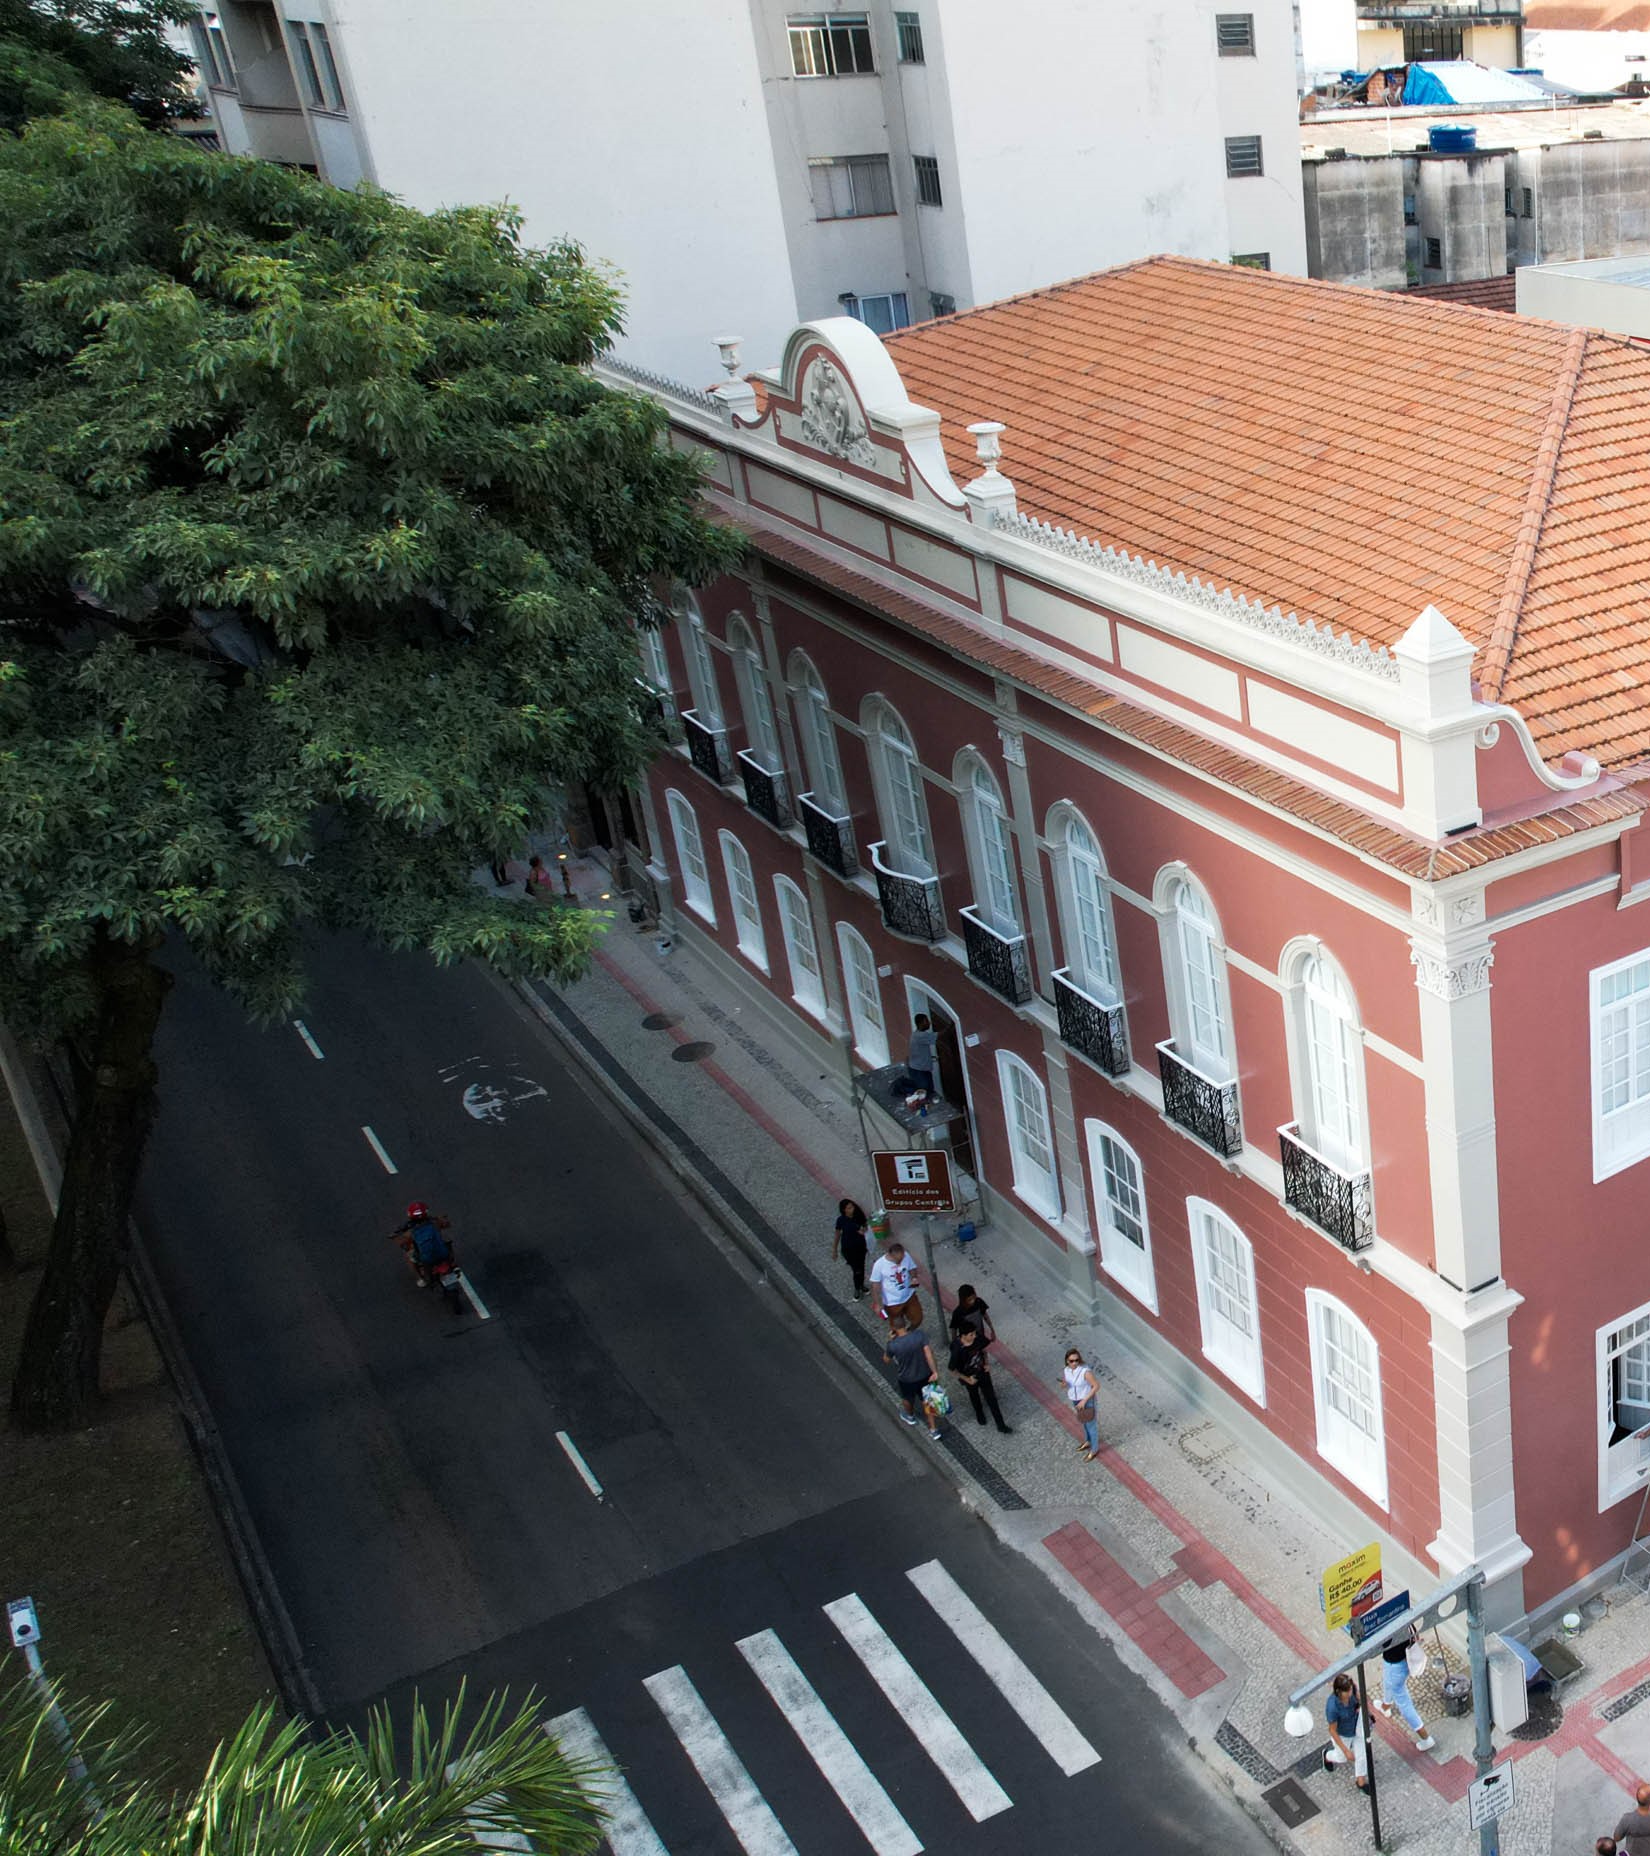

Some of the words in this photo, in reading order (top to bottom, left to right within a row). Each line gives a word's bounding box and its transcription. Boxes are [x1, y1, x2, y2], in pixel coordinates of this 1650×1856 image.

[1338, 1554, 1366, 1573] maxim
[1328, 1577, 1353, 1593] Ganhe
[1329, 1591, 1340, 1601] R$
[1362, 1612, 1378, 1624] Rua
